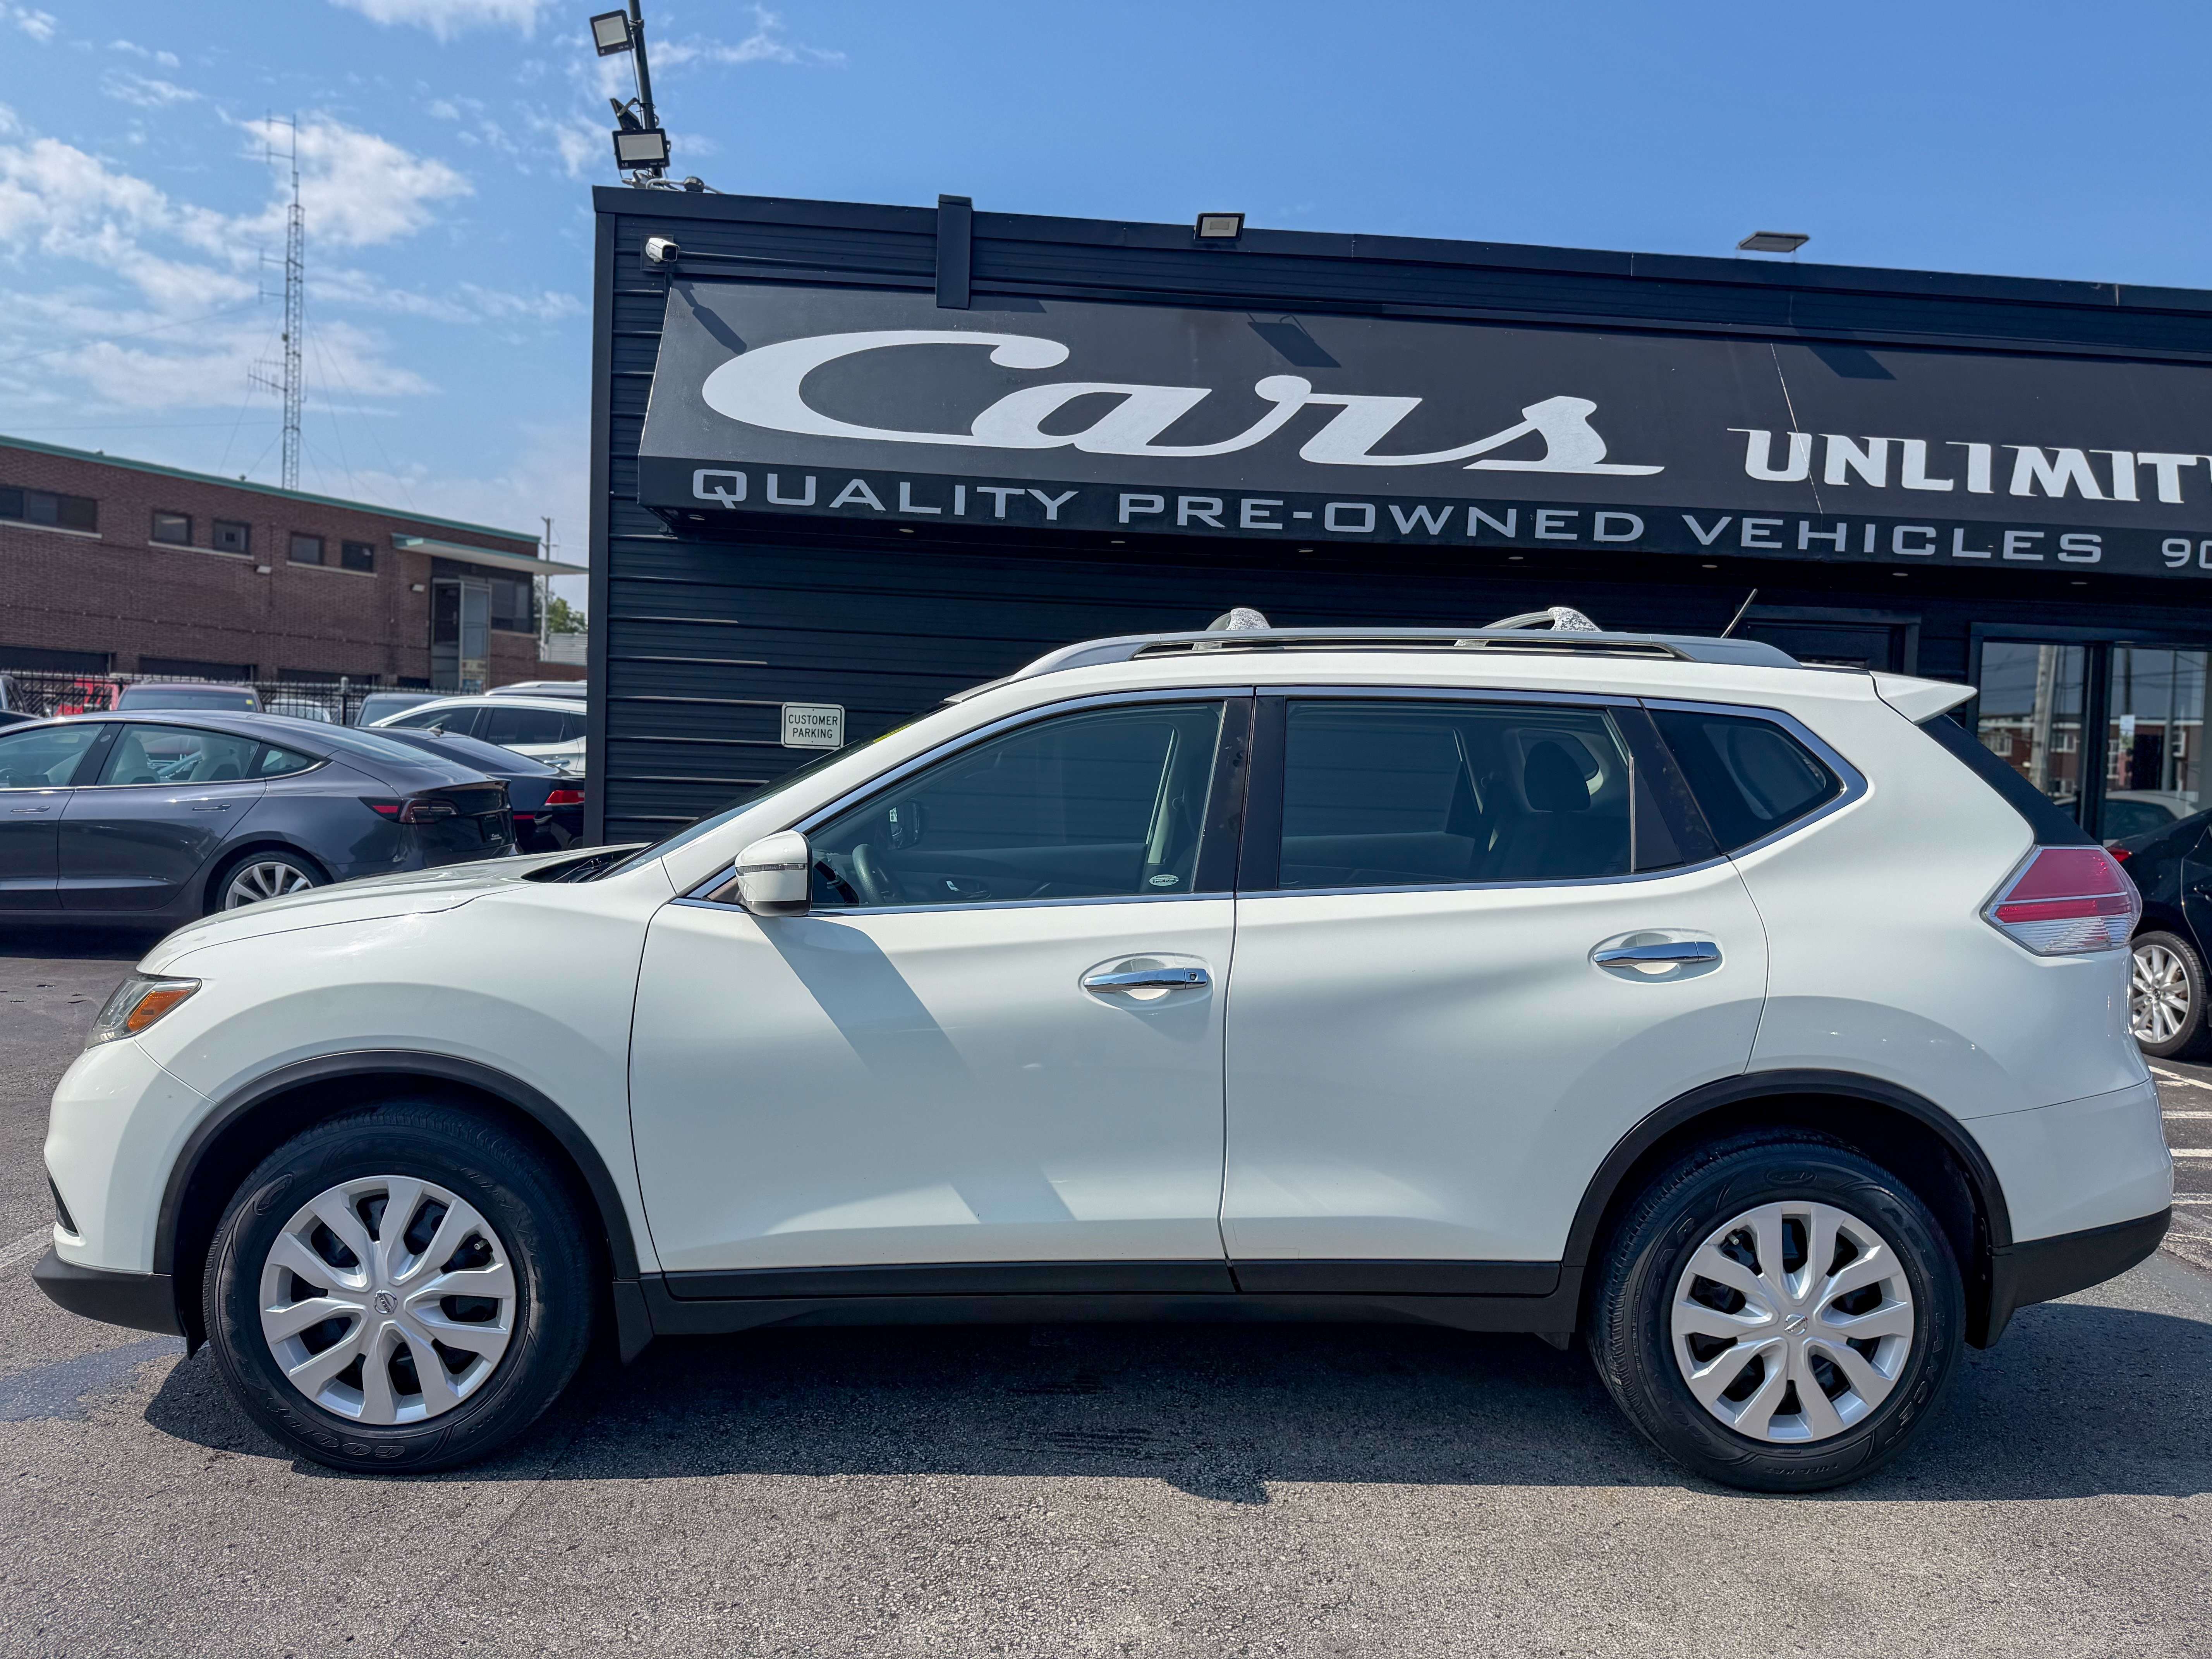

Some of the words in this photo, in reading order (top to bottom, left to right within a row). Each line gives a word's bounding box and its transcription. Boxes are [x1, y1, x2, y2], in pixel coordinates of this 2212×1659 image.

[702, 330, 1664, 475] Cars
[1727, 428, 2212, 503] UNLIMIT
[693, 469, 1079, 520] QUALITY
[1119, 493, 1644, 542] PRE-OWNED
[1682, 515, 2102, 563] VEHICLES
[788, 714, 838, 725] CUSTOMER
[793, 728, 833, 738] PARKING
